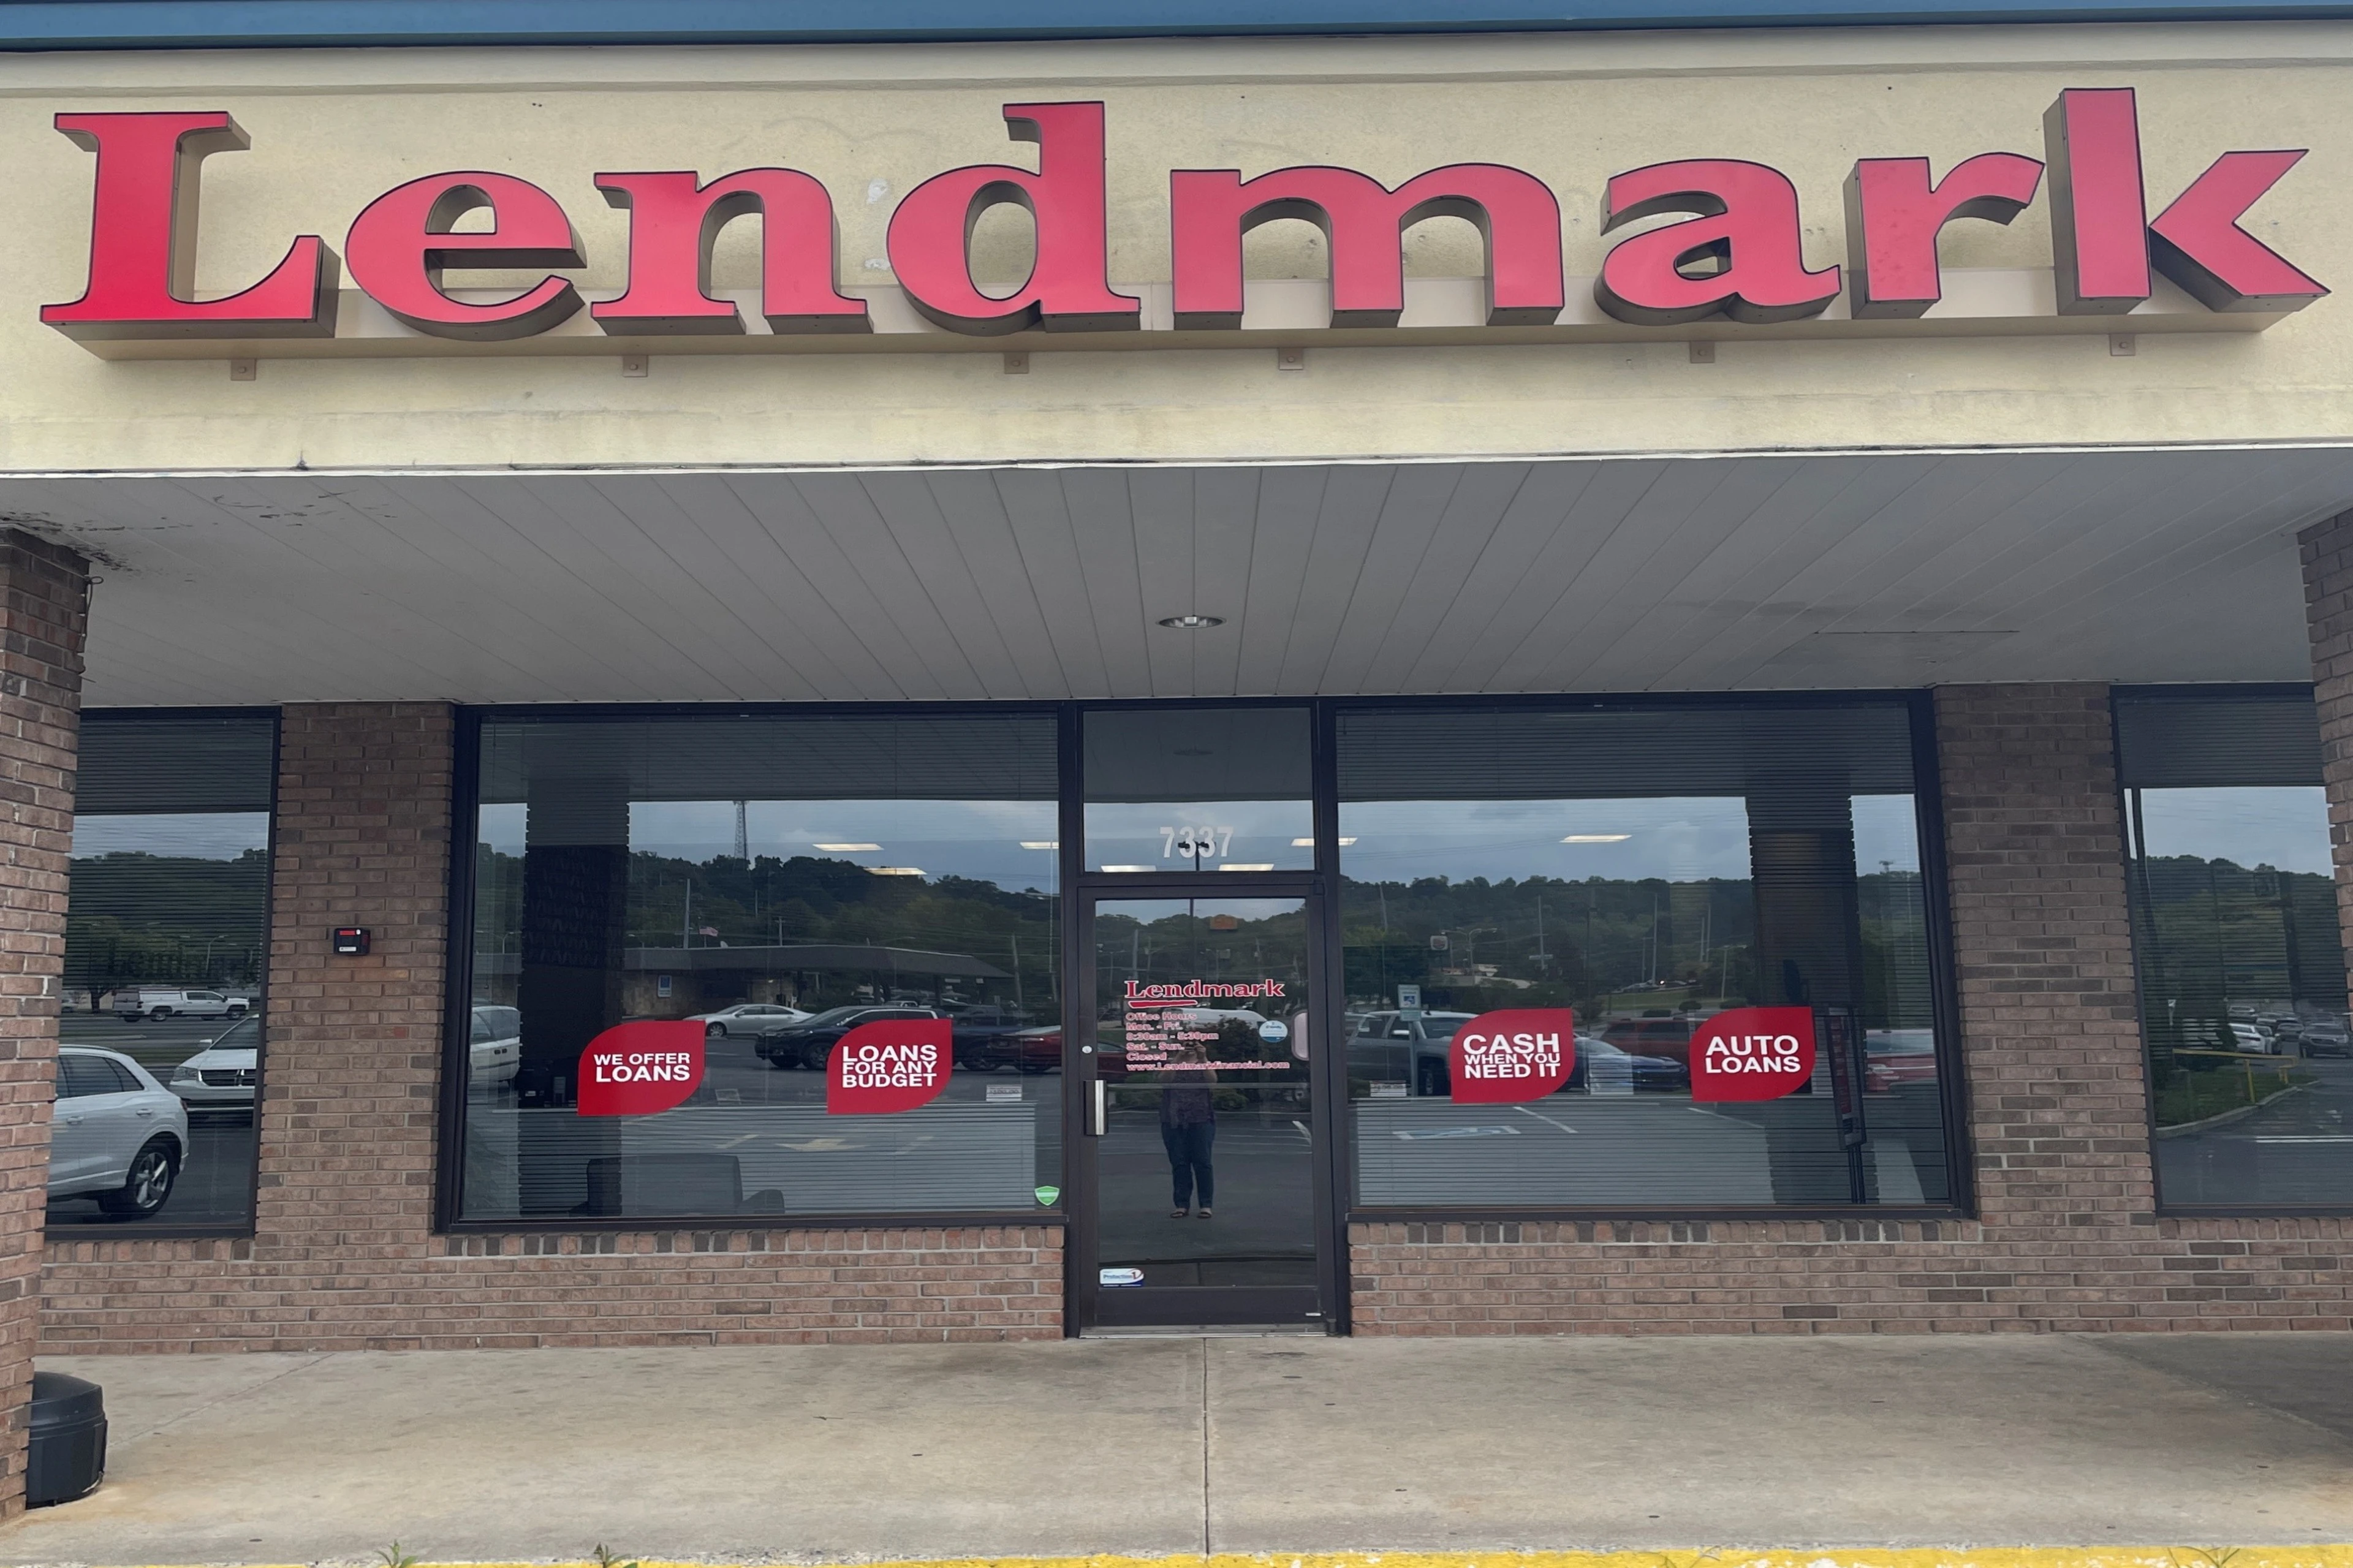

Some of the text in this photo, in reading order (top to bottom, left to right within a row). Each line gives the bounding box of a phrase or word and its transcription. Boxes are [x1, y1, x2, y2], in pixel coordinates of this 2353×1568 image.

[40, 87, 2332, 341] Lendmark
[1159, 826, 1234, 858] 7337
[1124, 979, 1286, 998] Lendmark
[1126, 1012, 1197, 1021] Office Hours
[1126, 1022, 1154, 1031] Mon.
[1164, 1021, 1183, 1031] Fri.
[1177, 1031, 1219, 1041] 5:30pm
[1463, 1032, 1559, 1054] CASH
[842, 1044, 937, 1062] LOANS
[1126, 1042, 1149, 1051] Sat.
[1158, 1042, 1185, 1050] Sun.
[1705, 1035, 1799, 1056] AUTO
[593, 1053, 690, 1066] WE OFFER
[1126, 1052, 1167, 1061] Closed
[1464, 1053, 1561, 1065] WHEN YOU
[842, 1061, 937, 1075] FOR ANY
[1465, 1063, 1561, 1078] NEED IT
[1705, 1056, 1801, 1074] LOANS
[596, 1065, 690, 1082] LOANS
[842, 1073, 937, 1088] BUDGET
